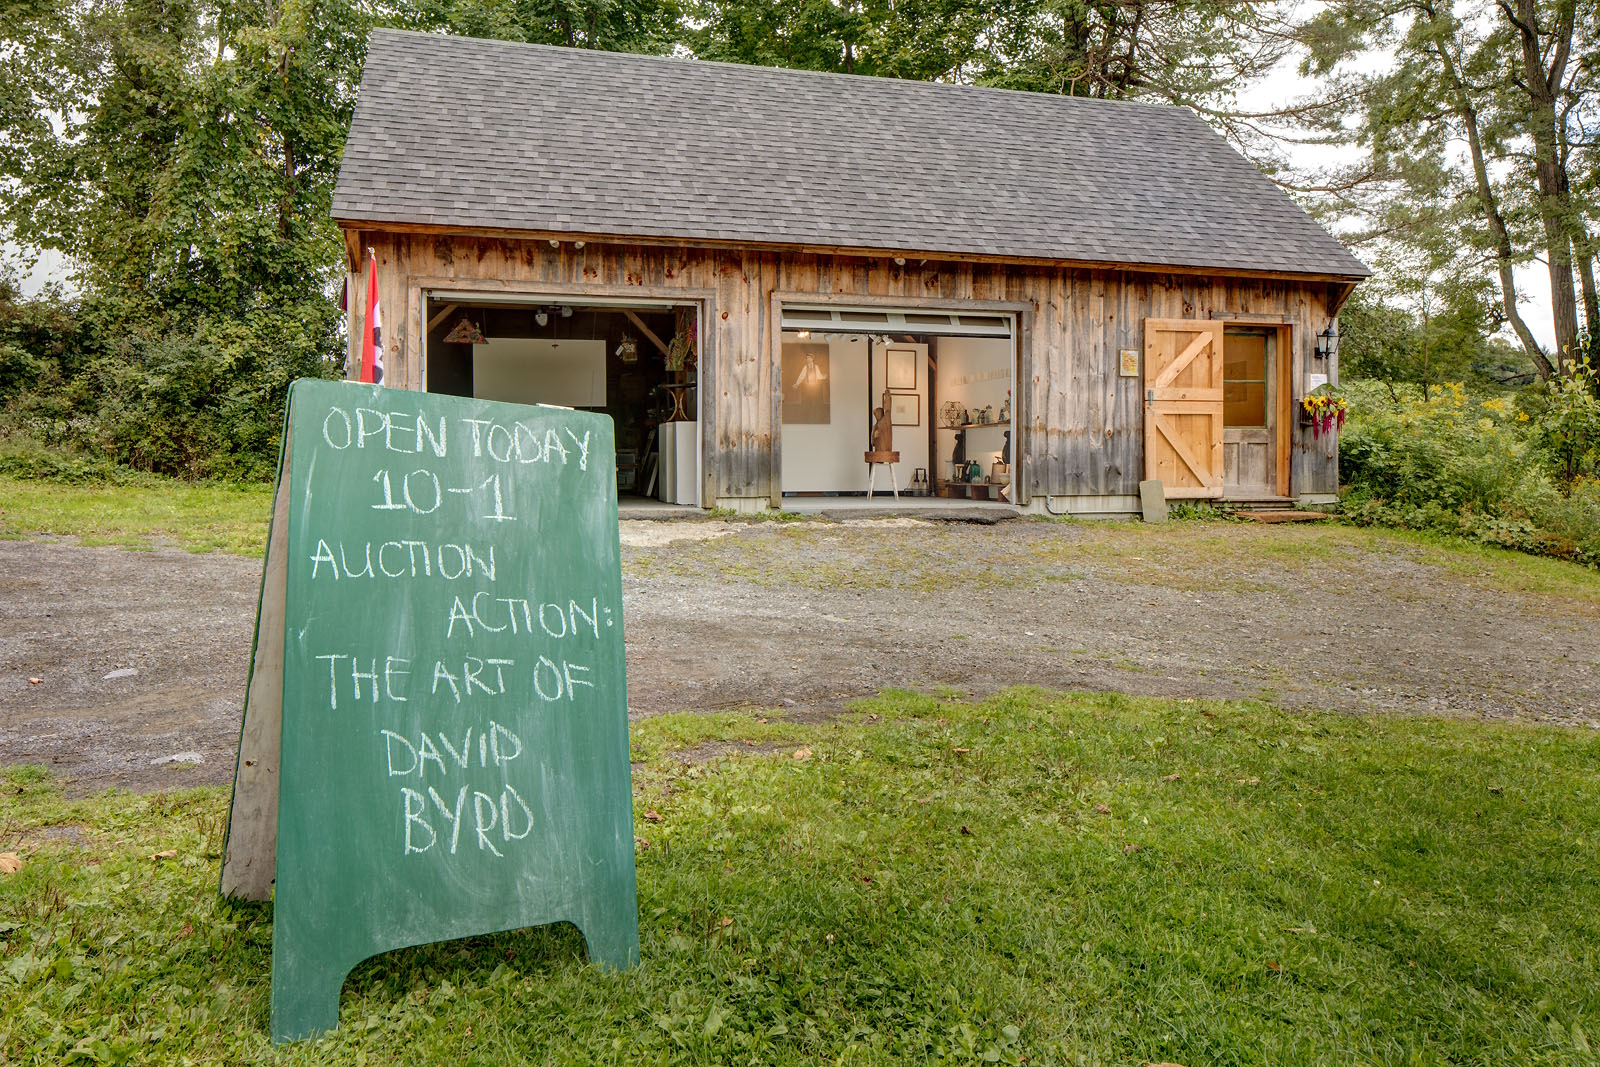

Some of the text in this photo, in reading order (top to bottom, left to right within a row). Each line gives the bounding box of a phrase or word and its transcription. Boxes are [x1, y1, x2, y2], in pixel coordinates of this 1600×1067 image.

[323, 406, 590, 472] OPEN TODAY
[371, 469, 517, 523] 10-1
[310, 538, 496, 581] AUCTION
[447, 592, 613, 639] ACTION:
[315, 652, 594, 710] THE ART OF
[380, 720, 523, 777] DAVID
[400, 783, 534, 858] BYRD
